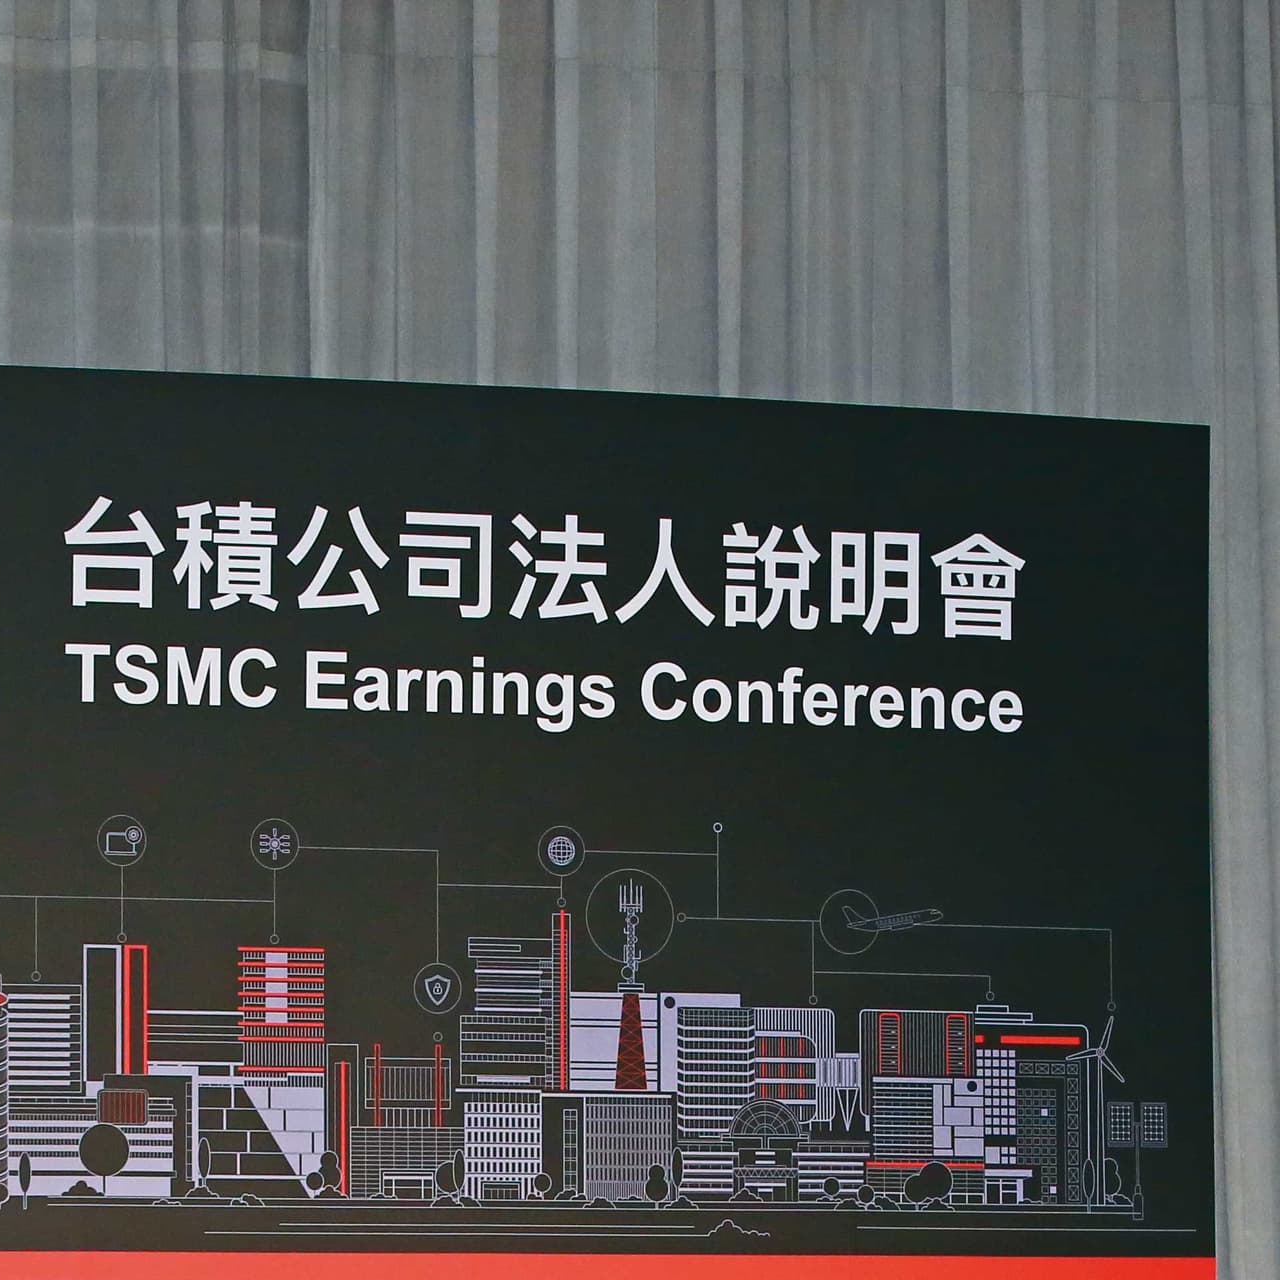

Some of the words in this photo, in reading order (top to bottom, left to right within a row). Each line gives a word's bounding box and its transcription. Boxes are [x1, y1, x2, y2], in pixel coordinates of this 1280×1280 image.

[63, 495, 1026, 641] 台積公司法人說明會
[65, 643, 277, 708] TSMC
[305, 650, 616, 733] Earnings
[640, 661, 1024, 733] Conference
